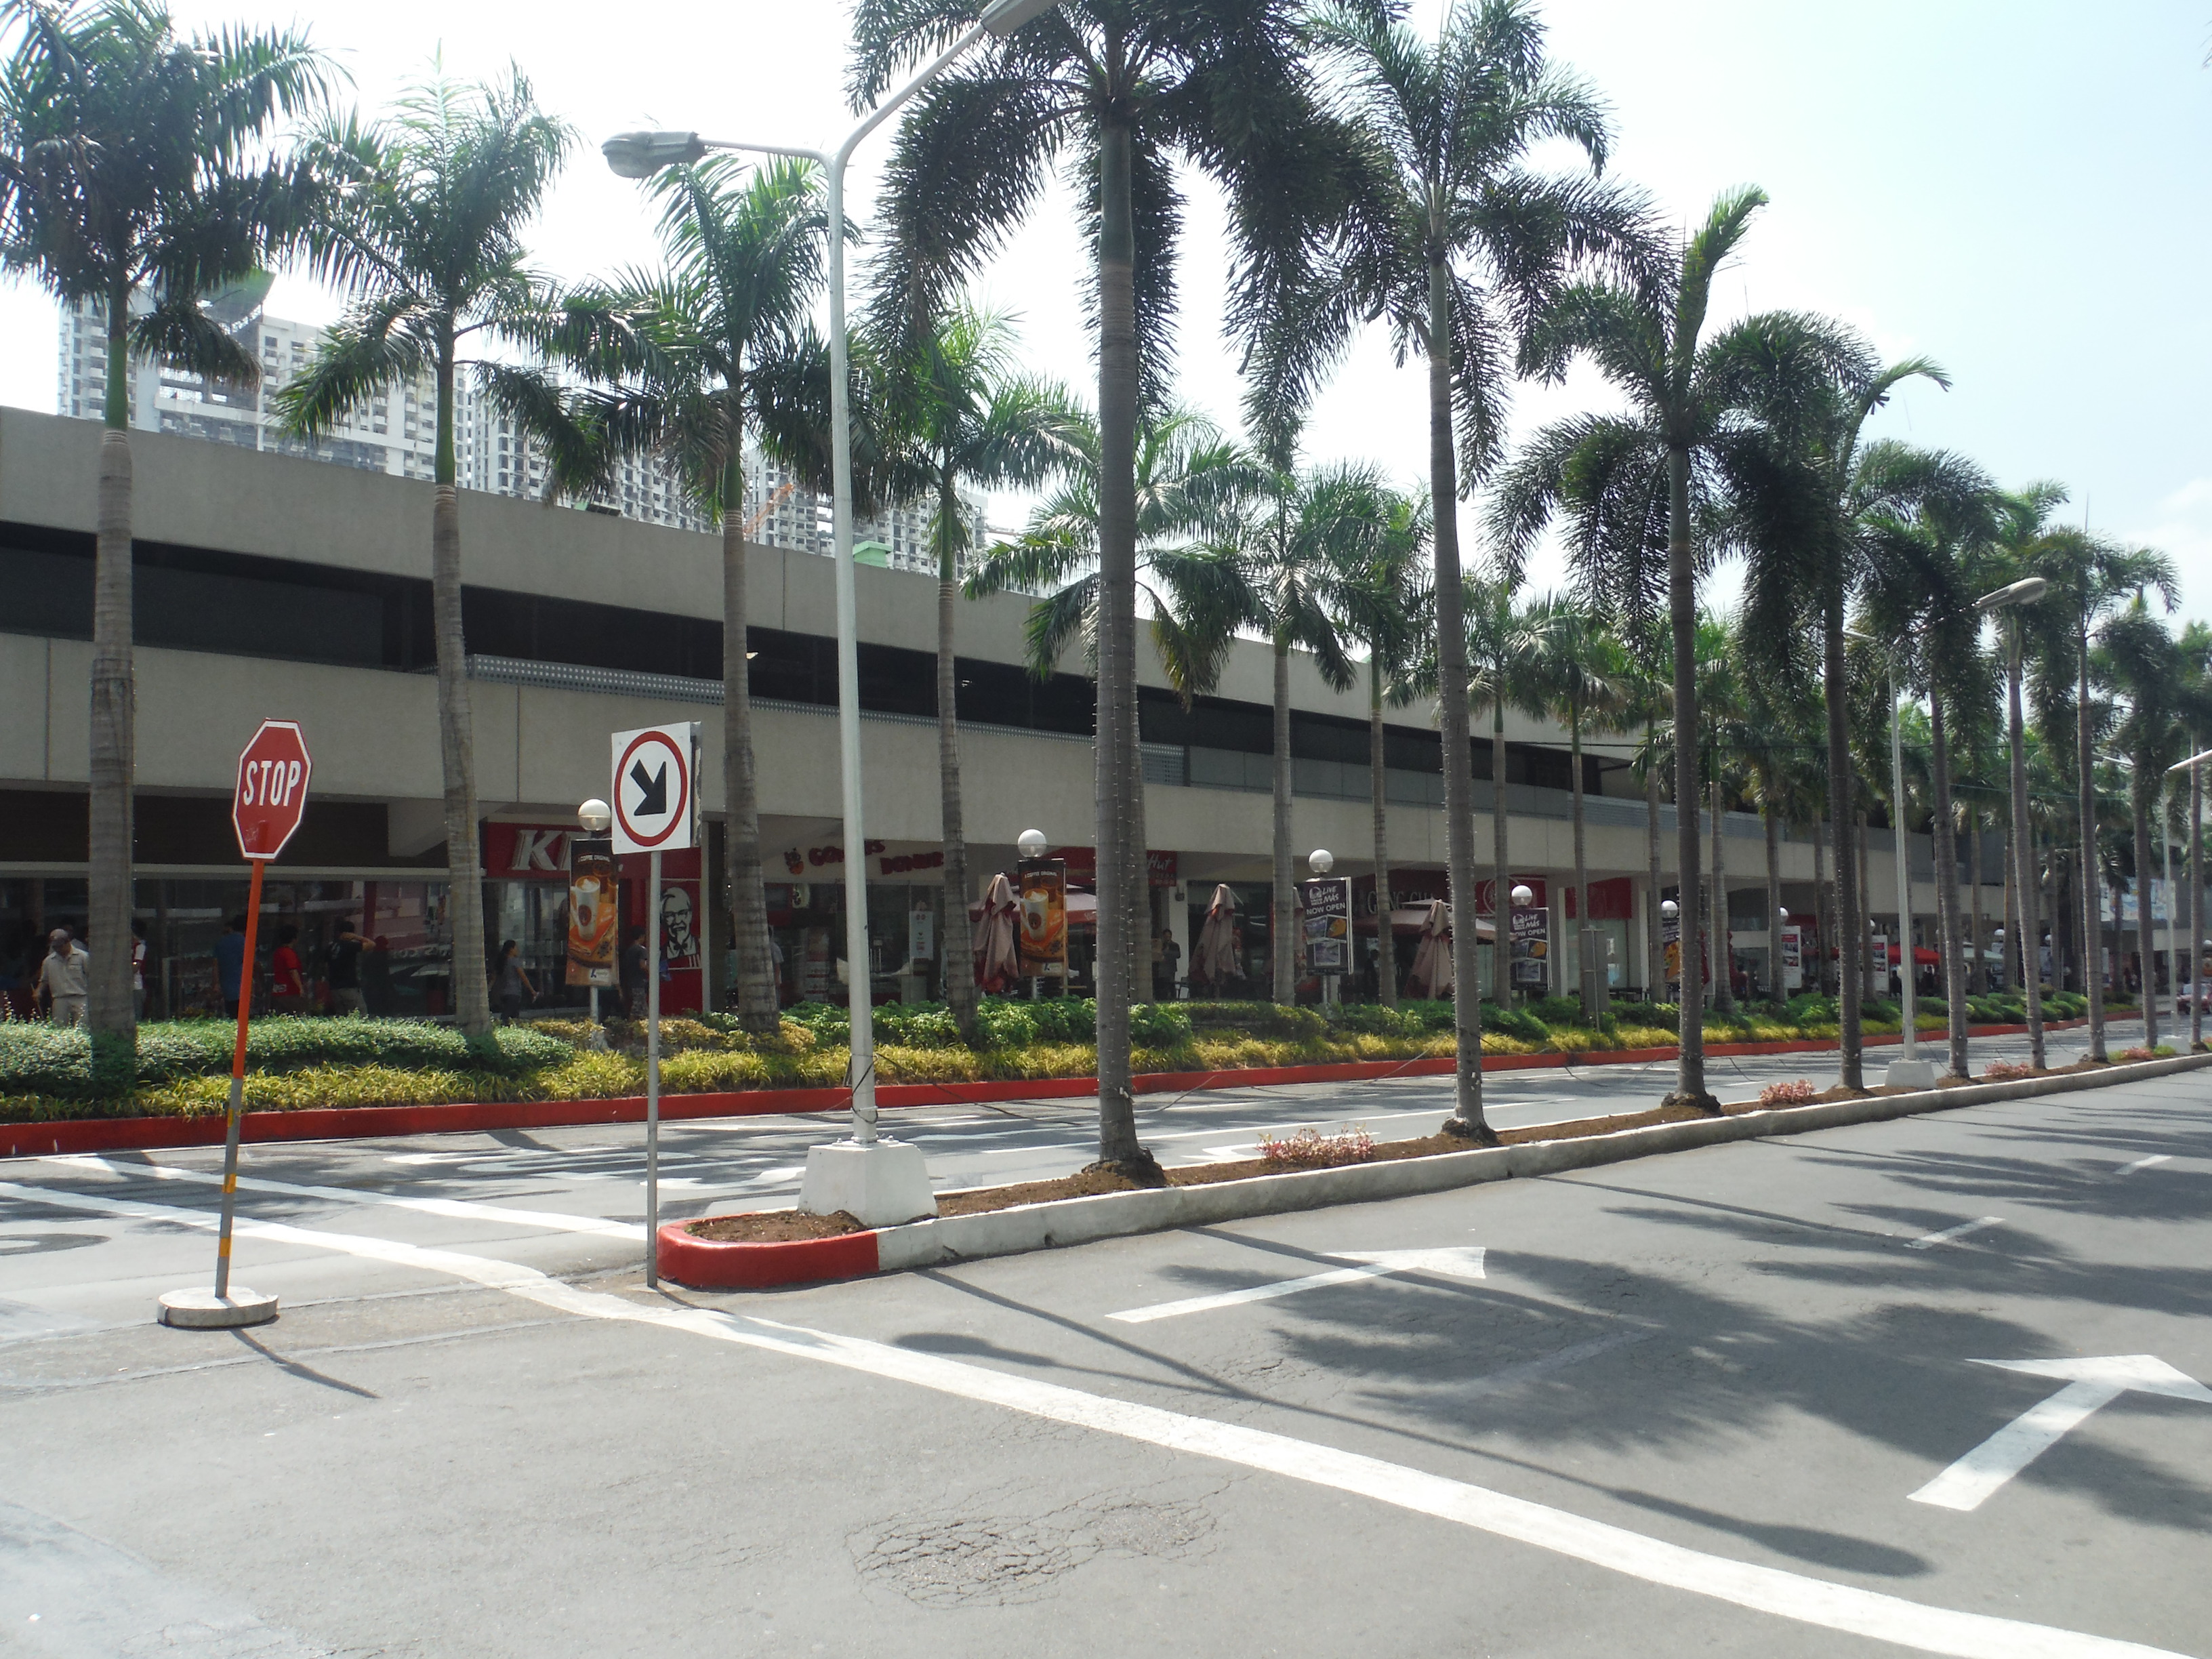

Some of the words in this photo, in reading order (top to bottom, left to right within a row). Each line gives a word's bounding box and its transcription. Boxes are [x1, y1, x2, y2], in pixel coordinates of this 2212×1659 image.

[243, 760, 301, 806] STOP
[1322, 886, 1337, 895] LIVE
[1307, 906, 1324, 915] NOW
[1326, 902, 1345, 912] OPEN
[1368, 890, 1405, 914] GNG
[1528, 928, 1546, 936] OPEN
